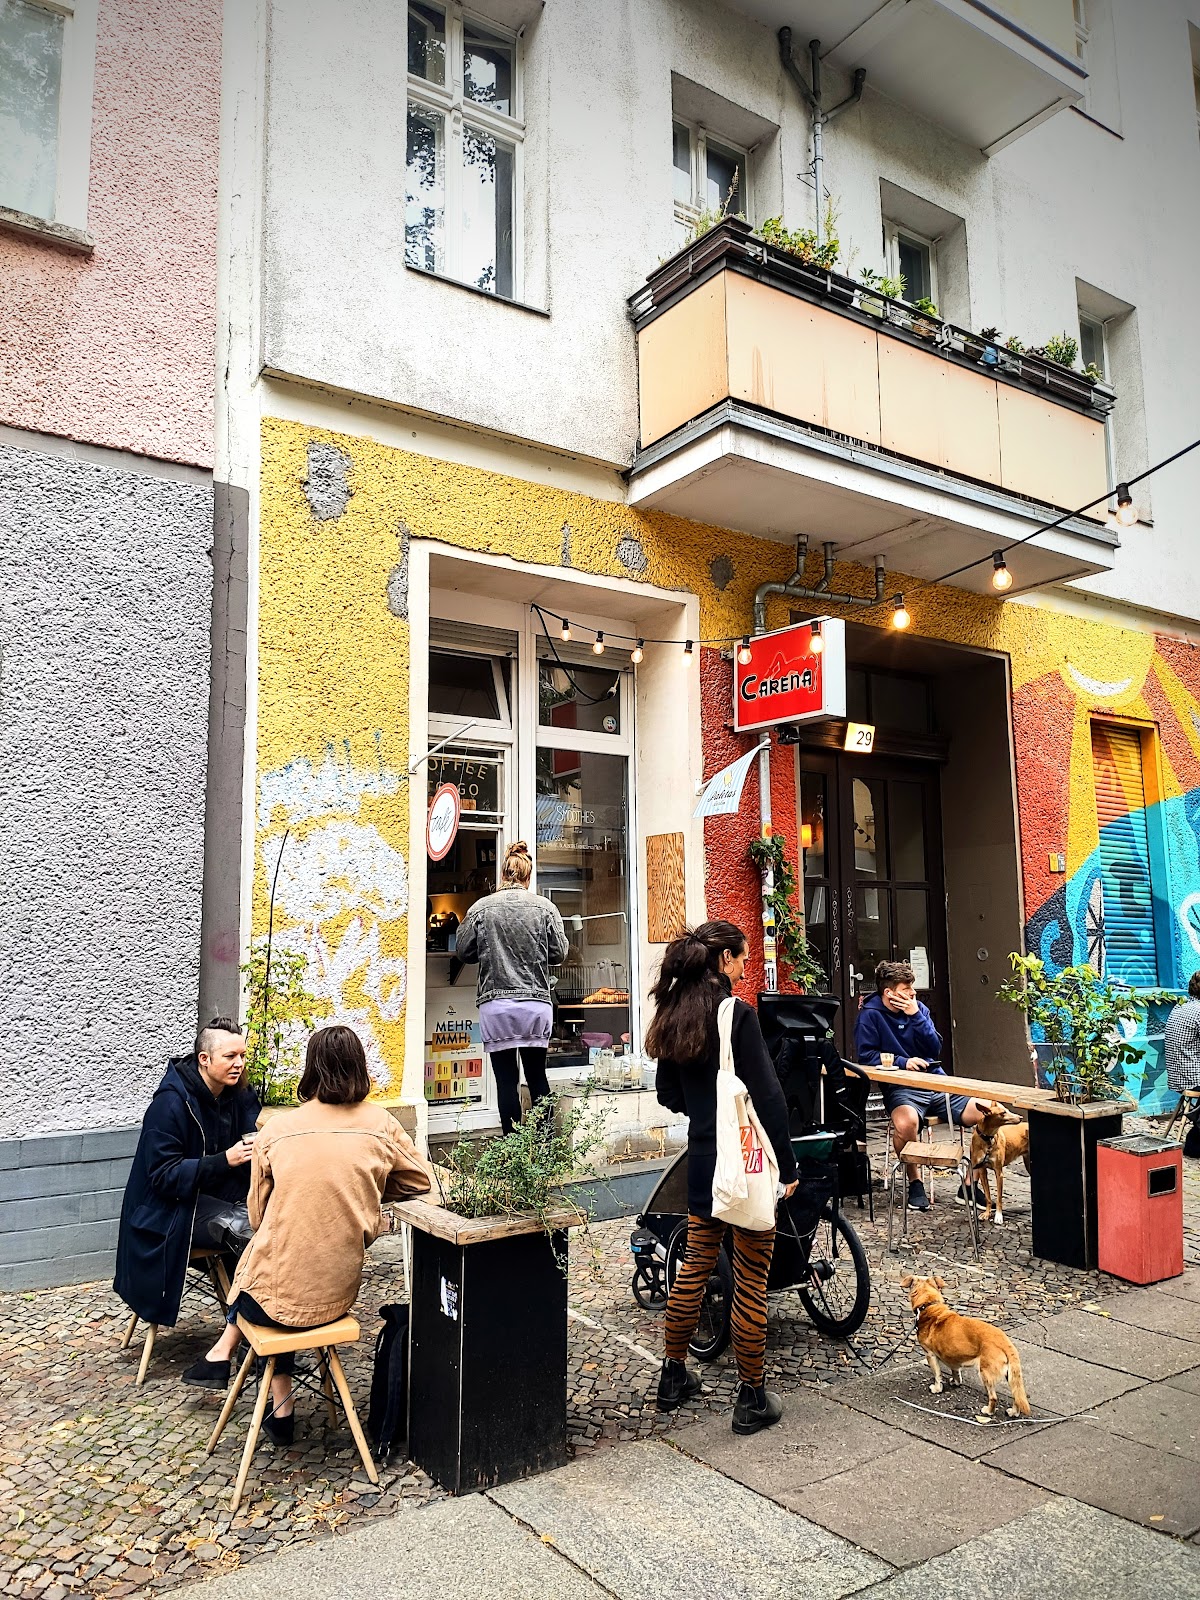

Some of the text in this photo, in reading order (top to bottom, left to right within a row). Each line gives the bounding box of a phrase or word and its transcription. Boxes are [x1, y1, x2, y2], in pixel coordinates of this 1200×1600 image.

[741, 670, 812, 701] CARENA
[856, 730, 872, 746] 29
[428, 757, 488, 780] OFFEE
[457, 782, 479, 796] GO
[435, 1019, 473, 1032] MEHR
[435, 1032, 471, 1045] MMH.
